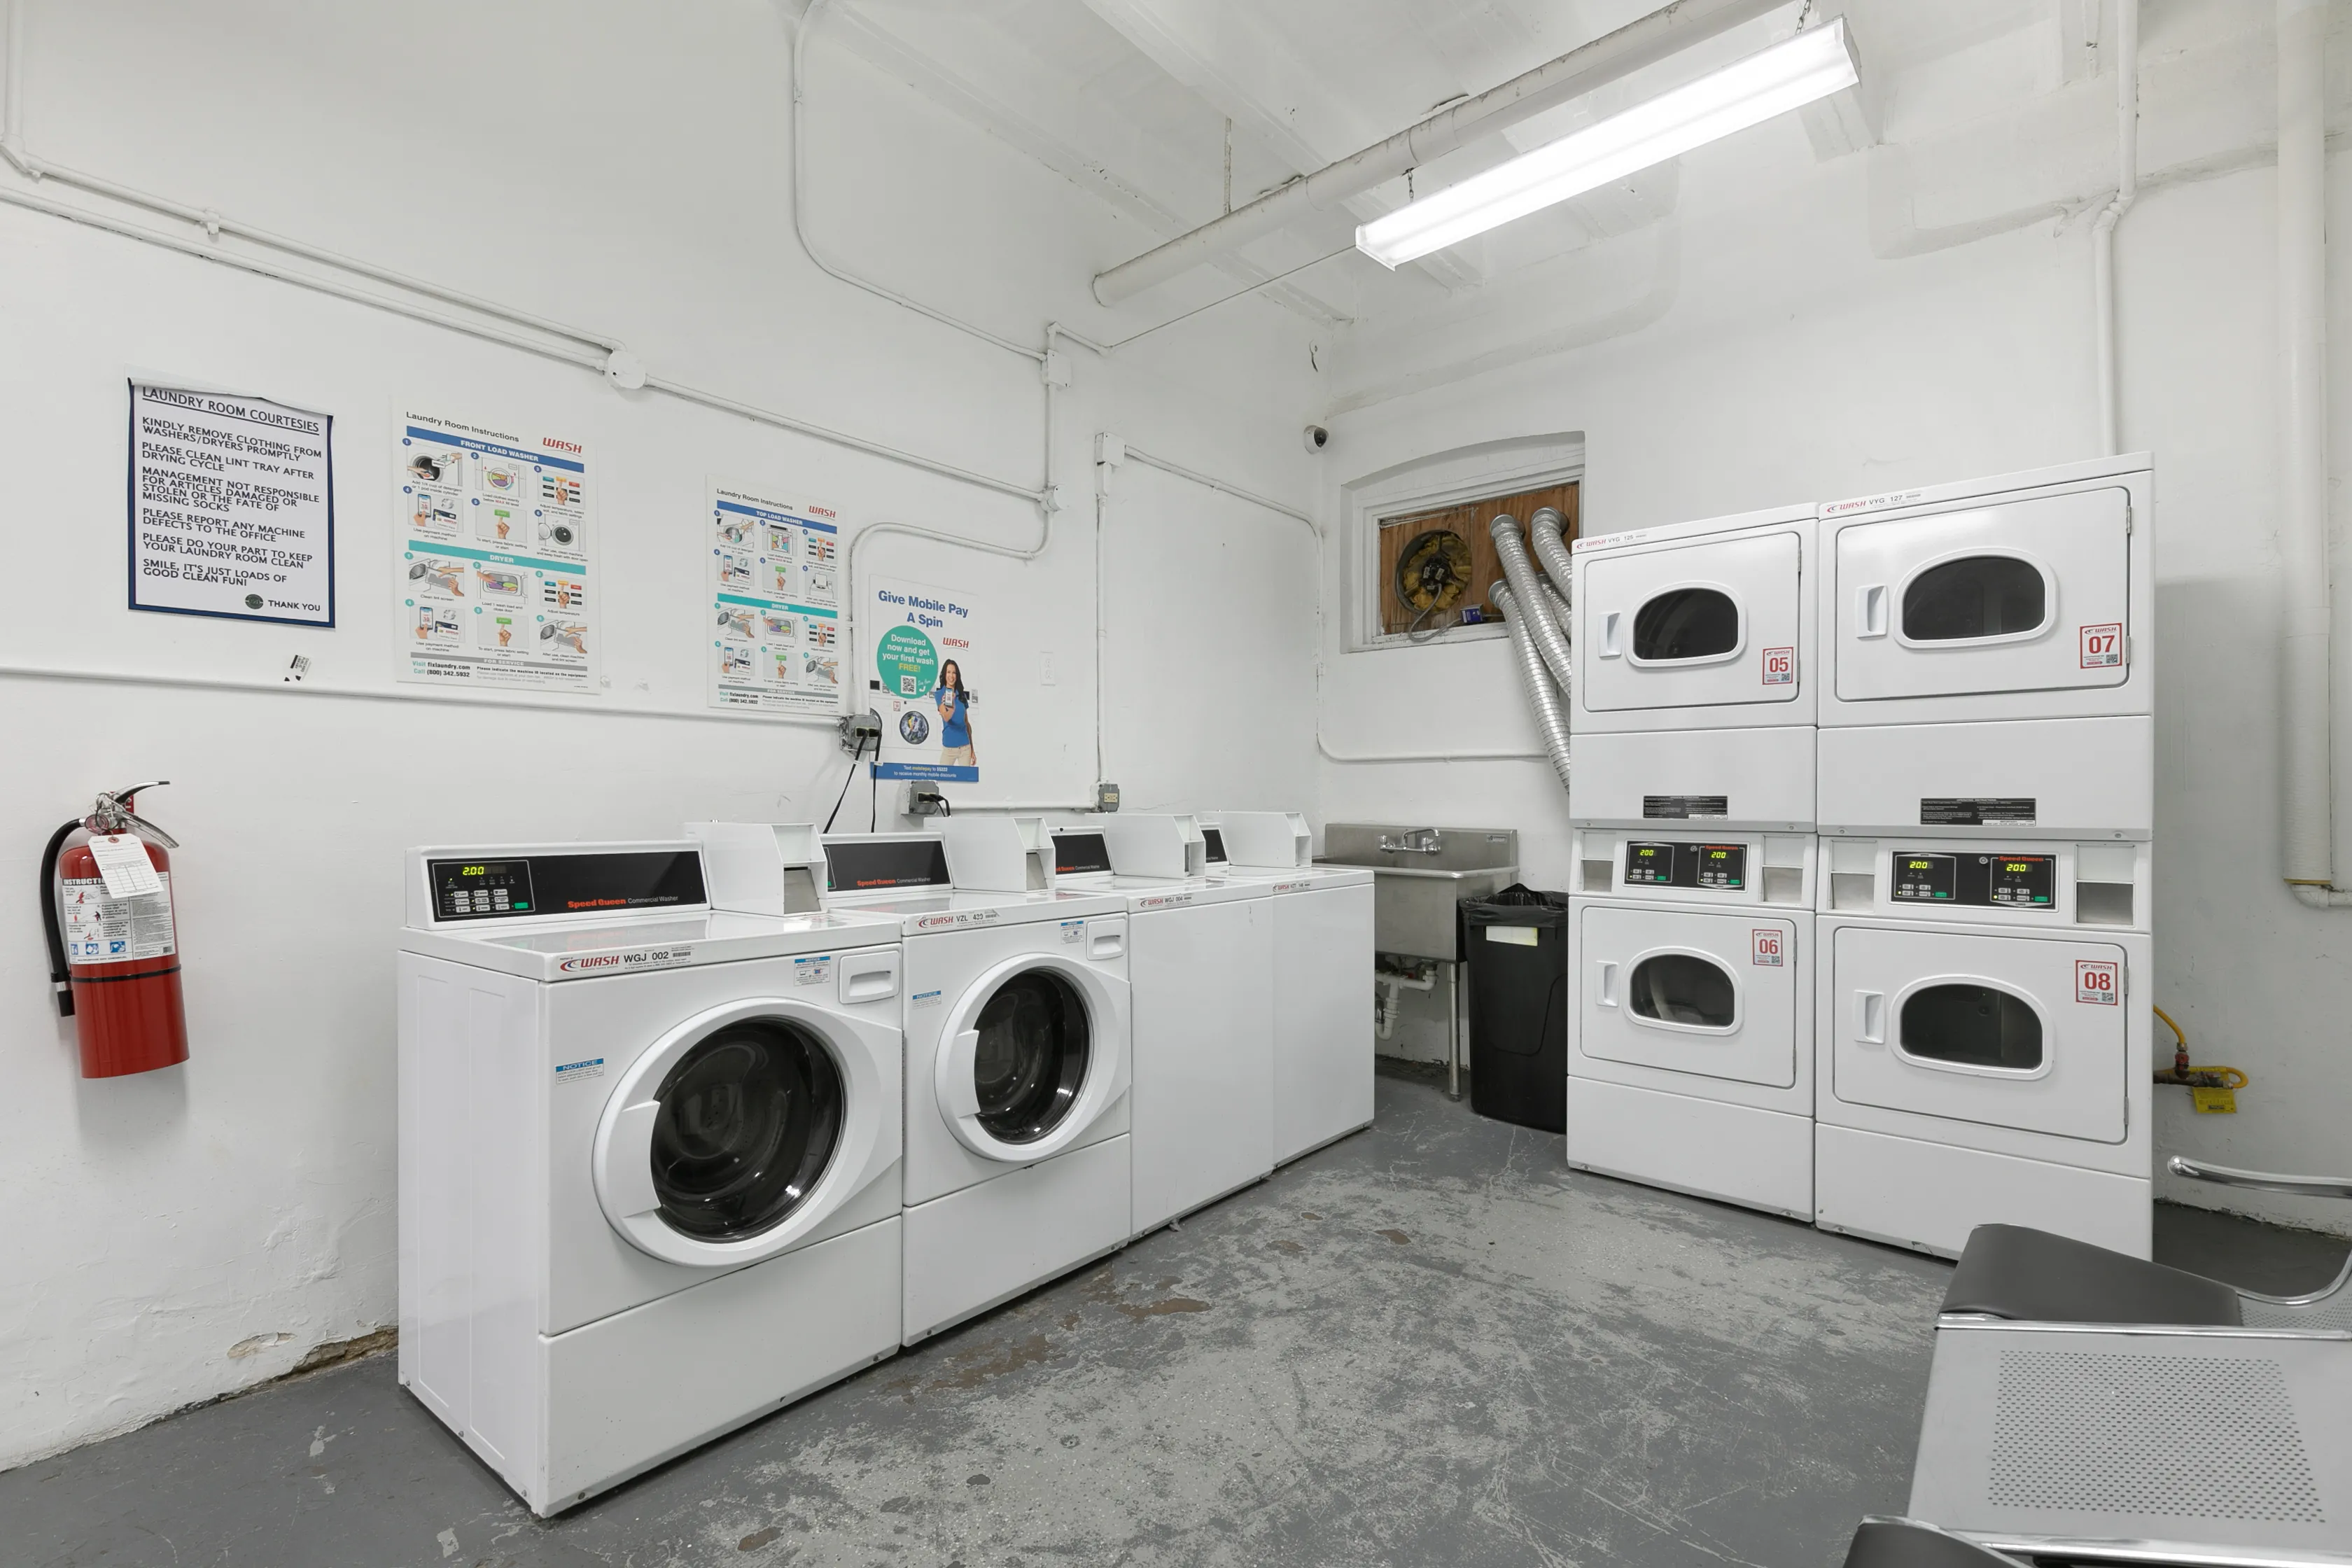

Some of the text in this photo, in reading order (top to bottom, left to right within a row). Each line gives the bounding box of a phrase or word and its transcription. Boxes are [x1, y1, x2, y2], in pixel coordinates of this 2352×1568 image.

[143, 387, 319, 432] LAUNDRY ROOM COURTESIES
[406, 412, 519, 442] Laundry Room Instructions
[143, 417, 321, 458] KINDLY REMOVE CLOTHING FROM
[143, 426, 300, 461] WASHERS/DRYERS PROMPTLY
[543, 438, 582, 454] WASH
[461, 440, 538, 461] FRONT LOAD WASHER
[142, 442, 314, 479] PLEASE CLEAN LINT TRAY AFTER
[143, 451, 225, 471] DRYING CYCLE
[142, 466, 319, 502] MANAGEMENT NOT RESPONSIBLE
[143, 475, 297, 507] FOR ARTICLES DAMAGED OR
[143, 484, 279, 511] STOLEN OR THE FATE OF
[143, 492, 229, 512] MISSING SOCKS
[717, 489, 793, 510] Laundry Room Instructions
[1840, 501, 1866, 510] WASH
[782, 517, 803, 525] WASHER
[809, 505, 836, 518] WASH
[143, 508, 305, 538] PLEASE REPORT ANY MACHINE
[143, 517, 276, 542] DEFECTS TO THE OFFICE
[143, 533, 312, 561] PLEASE DO YOUR PART TO KEEP
[144, 542, 303, 568] YOUR LAUNDRY ROOM CLEAN
[490, 554, 514, 563] DRYER
[144, 559, 287, 582] SMILE, IT'S JUST LOADS OF
[144, 567, 247, 586] GOOD CLEAN FUN!
[268, 600, 299, 610] THANK
[878, 590, 968, 617] Give Mobile Pay
[907, 612, 943, 627] A Spin
[891, 634, 925, 646] Download
[943, 638, 969, 648] WASH
[2089, 635, 2115, 654] 07
[919, 647, 930, 656] get
[899, 664, 920, 672] FREE!
[1770, 657, 1788, 672] 05
[463, 867, 484, 875] 2.00
[568, 899, 596, 909] Speed
[930, 916, 953, 925] WASH
[1759, 939, 1778, 954] 06
[581, 955, 620, 967] WASH
[624, 953, 647, 962] WGJ
[652, 951, 668, 960] 002
[2085, 972, 2110, 990] 08
[563, 1060, 598, 1070] NOTICE
